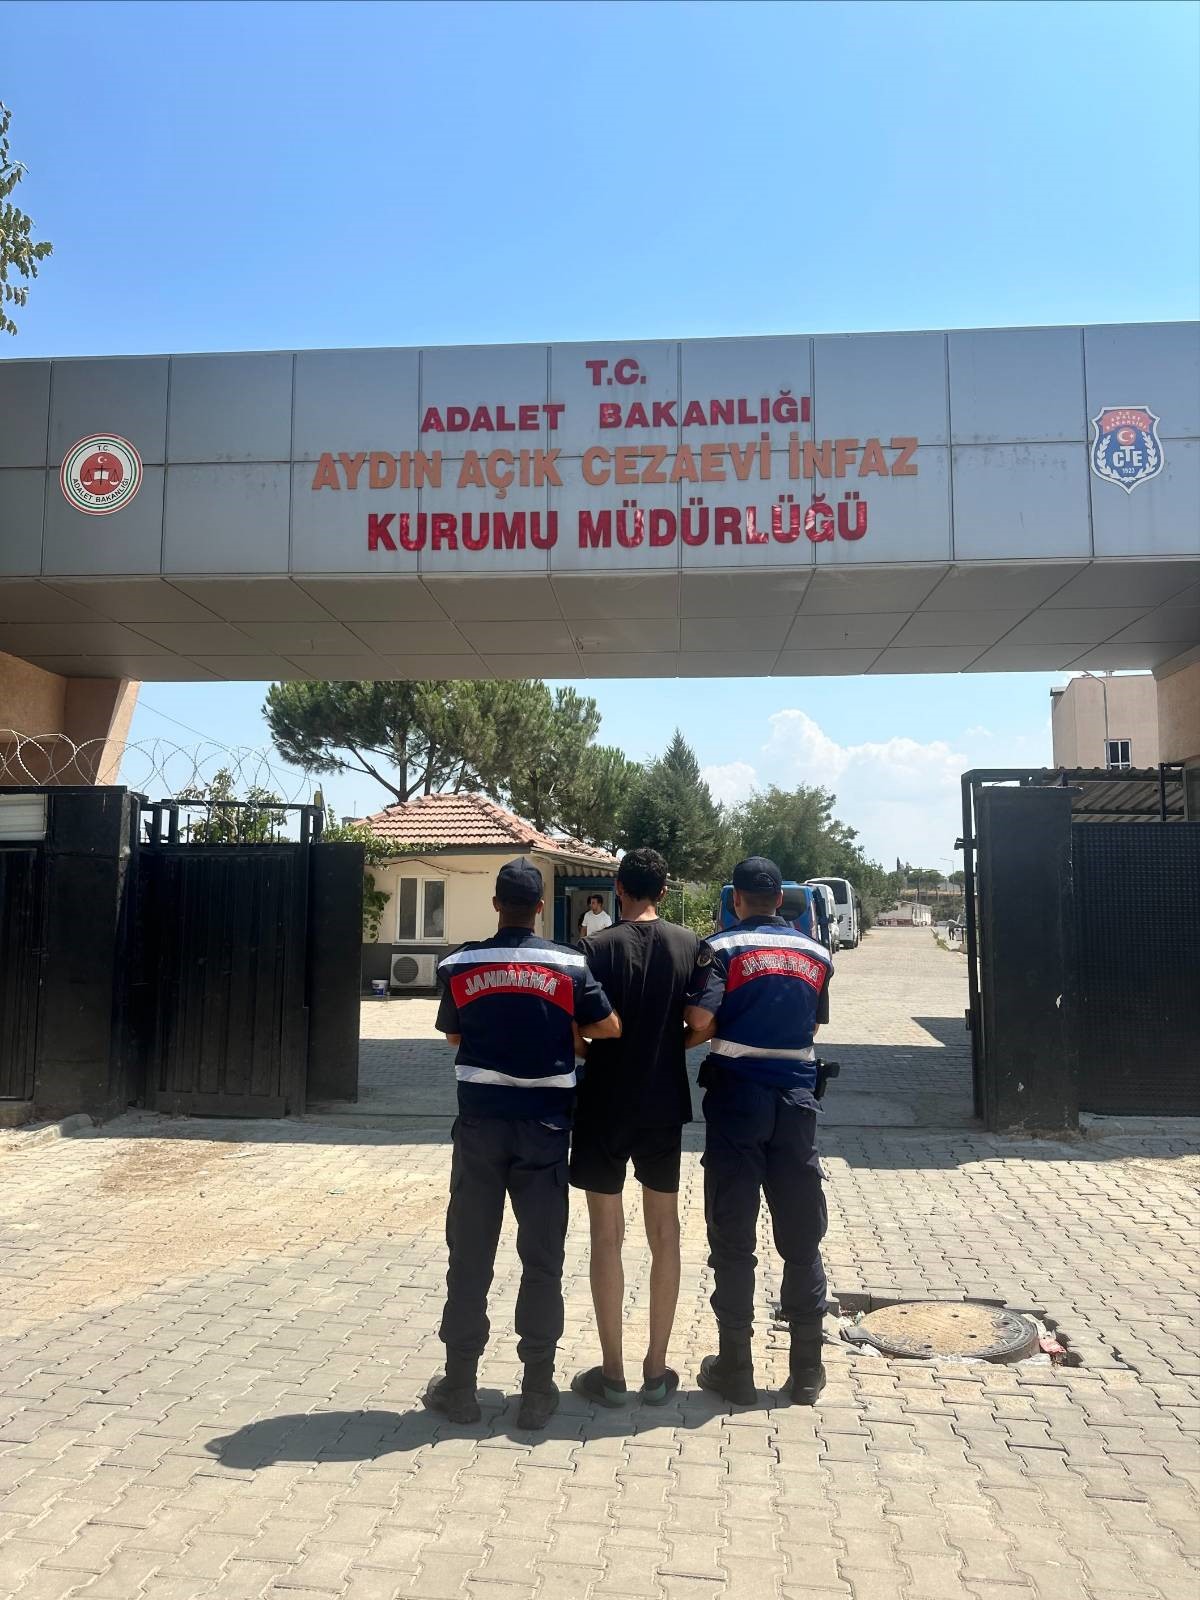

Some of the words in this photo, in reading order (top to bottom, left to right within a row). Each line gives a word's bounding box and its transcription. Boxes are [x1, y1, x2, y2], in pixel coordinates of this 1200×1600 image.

[585, 358, 647, 386] T.C.
[420, 403, 566, 433] ADALET
[599, 389, 811, 429] BAKANLIĞI
[311, 450, 443, 490] AYDIN
[456, 448, 564, 500] AÇIK
[580, 431, 772, 486] CEZAEVİ
[788, 430, 919, 479] İNFAZ
[1112, 445, 1143, 467] CTE
[72, 478, 94, 501] ADALET
[367, 510, 559, 552] KURUMU
[578, 490, 868, 549] MÜDÜRLÜĞÜ
[464, 968, 559, 997] JANDARMA
